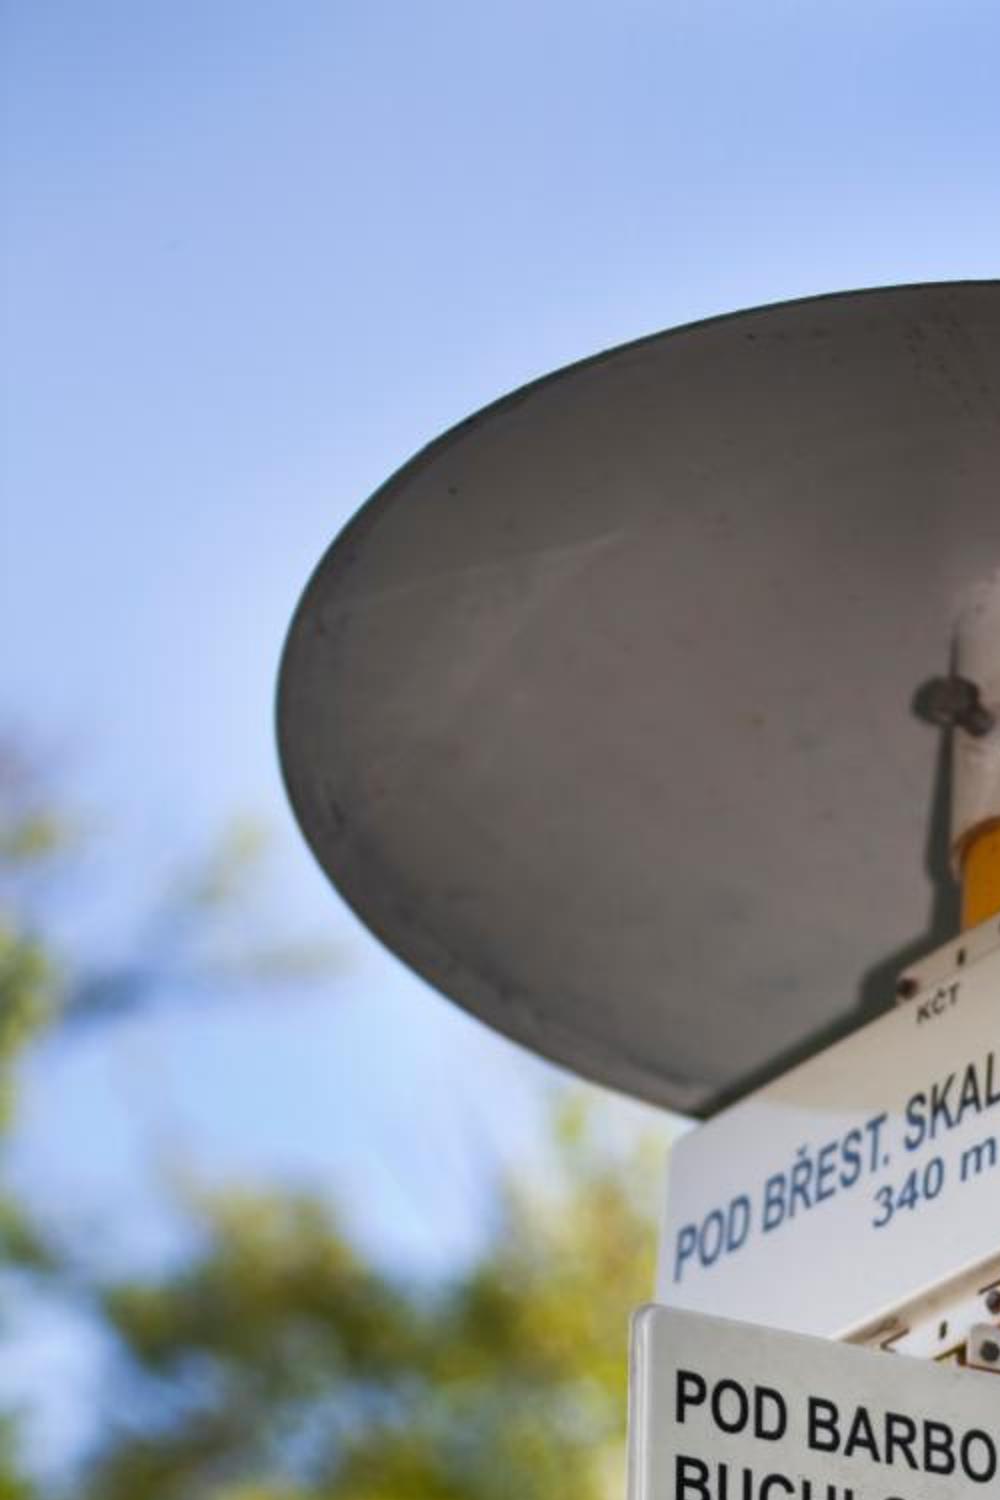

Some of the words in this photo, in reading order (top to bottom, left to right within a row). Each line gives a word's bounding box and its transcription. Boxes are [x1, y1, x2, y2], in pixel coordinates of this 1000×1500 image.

[916, 981, 962, 1024] KČT
[673, 1195, 750, 1284] POD
[761, 1113, 891, 1234] BŘEST.
[871, 1157, 945, 1230] 340
[960, 1135, 998, 1182] m
[675, 1369, 788, 1442] POD
